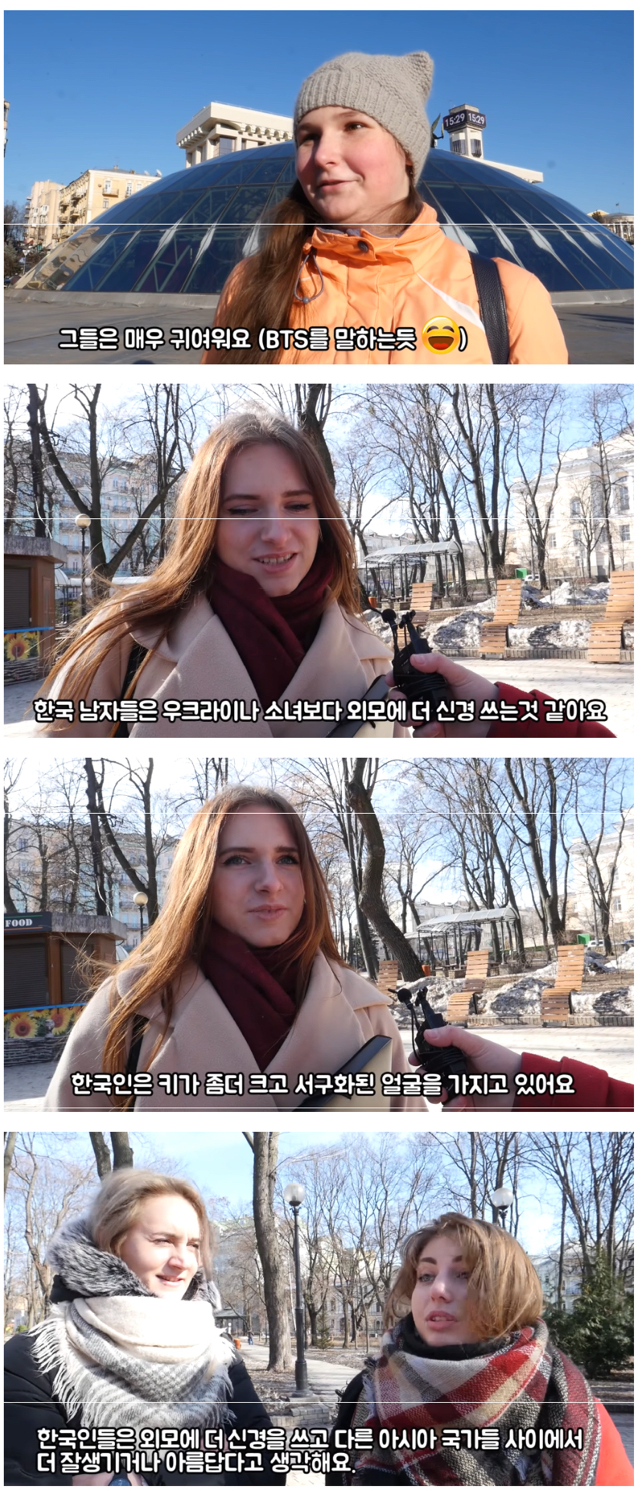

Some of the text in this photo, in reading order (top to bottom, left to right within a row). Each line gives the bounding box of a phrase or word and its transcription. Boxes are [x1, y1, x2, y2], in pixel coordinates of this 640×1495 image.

[445, 112, 485, 127] 15:29 15:29
[5, 918, 33, 928] FOOD
